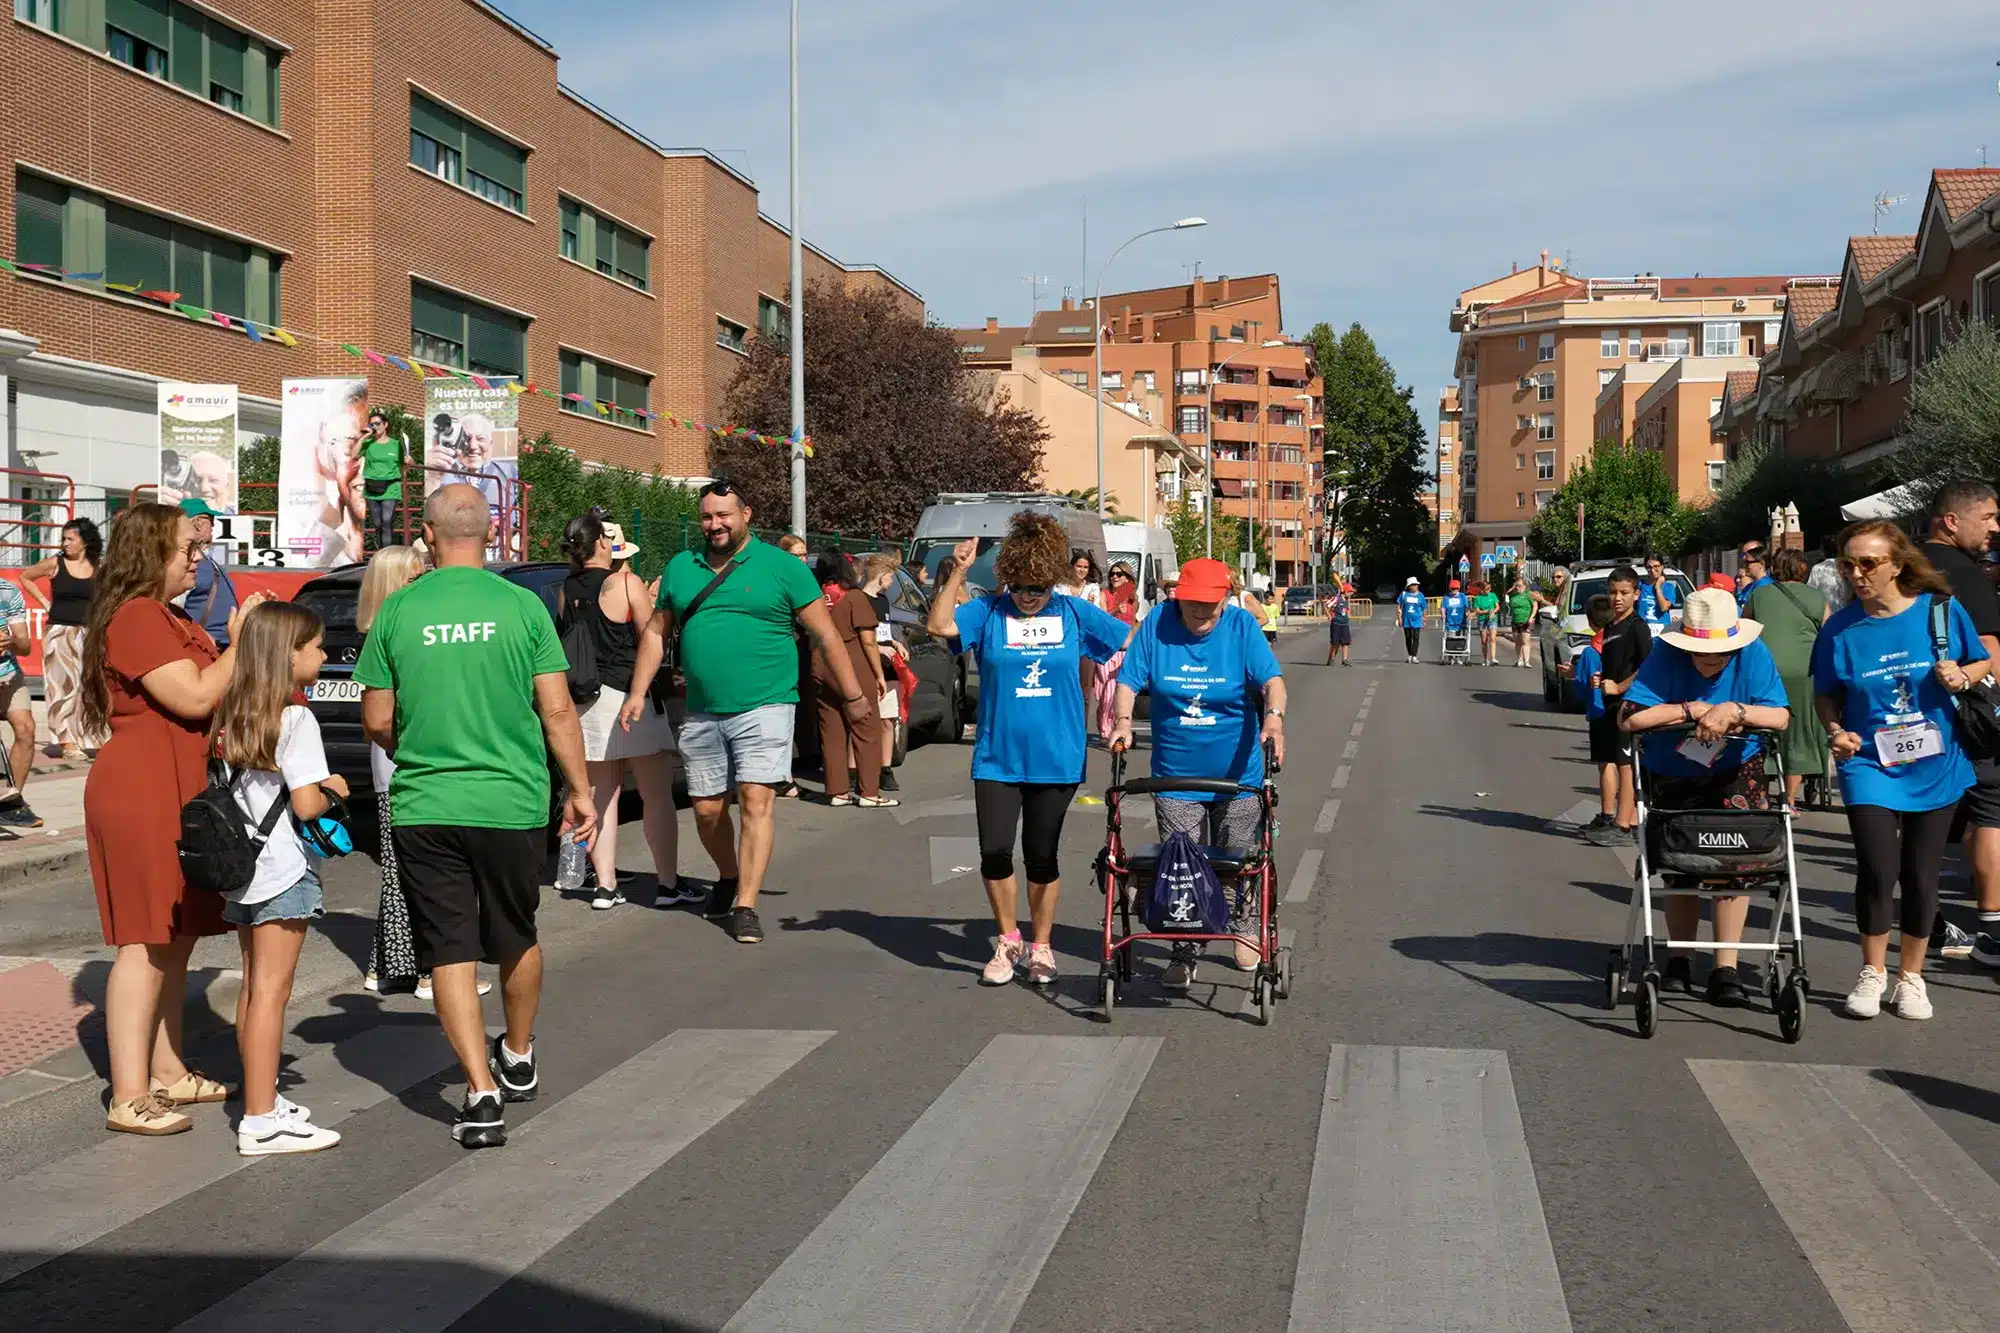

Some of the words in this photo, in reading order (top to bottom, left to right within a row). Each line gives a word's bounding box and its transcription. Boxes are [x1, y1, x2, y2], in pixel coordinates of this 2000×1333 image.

[186, 395, 229, 405] amavir
[434, 387, 480, 399] Nuestra
[482, 388, 509, 398] casa
[439, 402, 453, 411] es
[455, 400, 468, 410] tu
[470, 399, 504, 412] hogar
[215, 518, 237, 540] 1
[257, 549, 285, 568] 3
[422, 621, 496, 646] STAFF
[1022, 627, 1048, 638] 219
[317, 681, 360, 698] 8700
[1895, 738, 1924, 753] 267
[1698, 832, 1749, 848] KMINA
